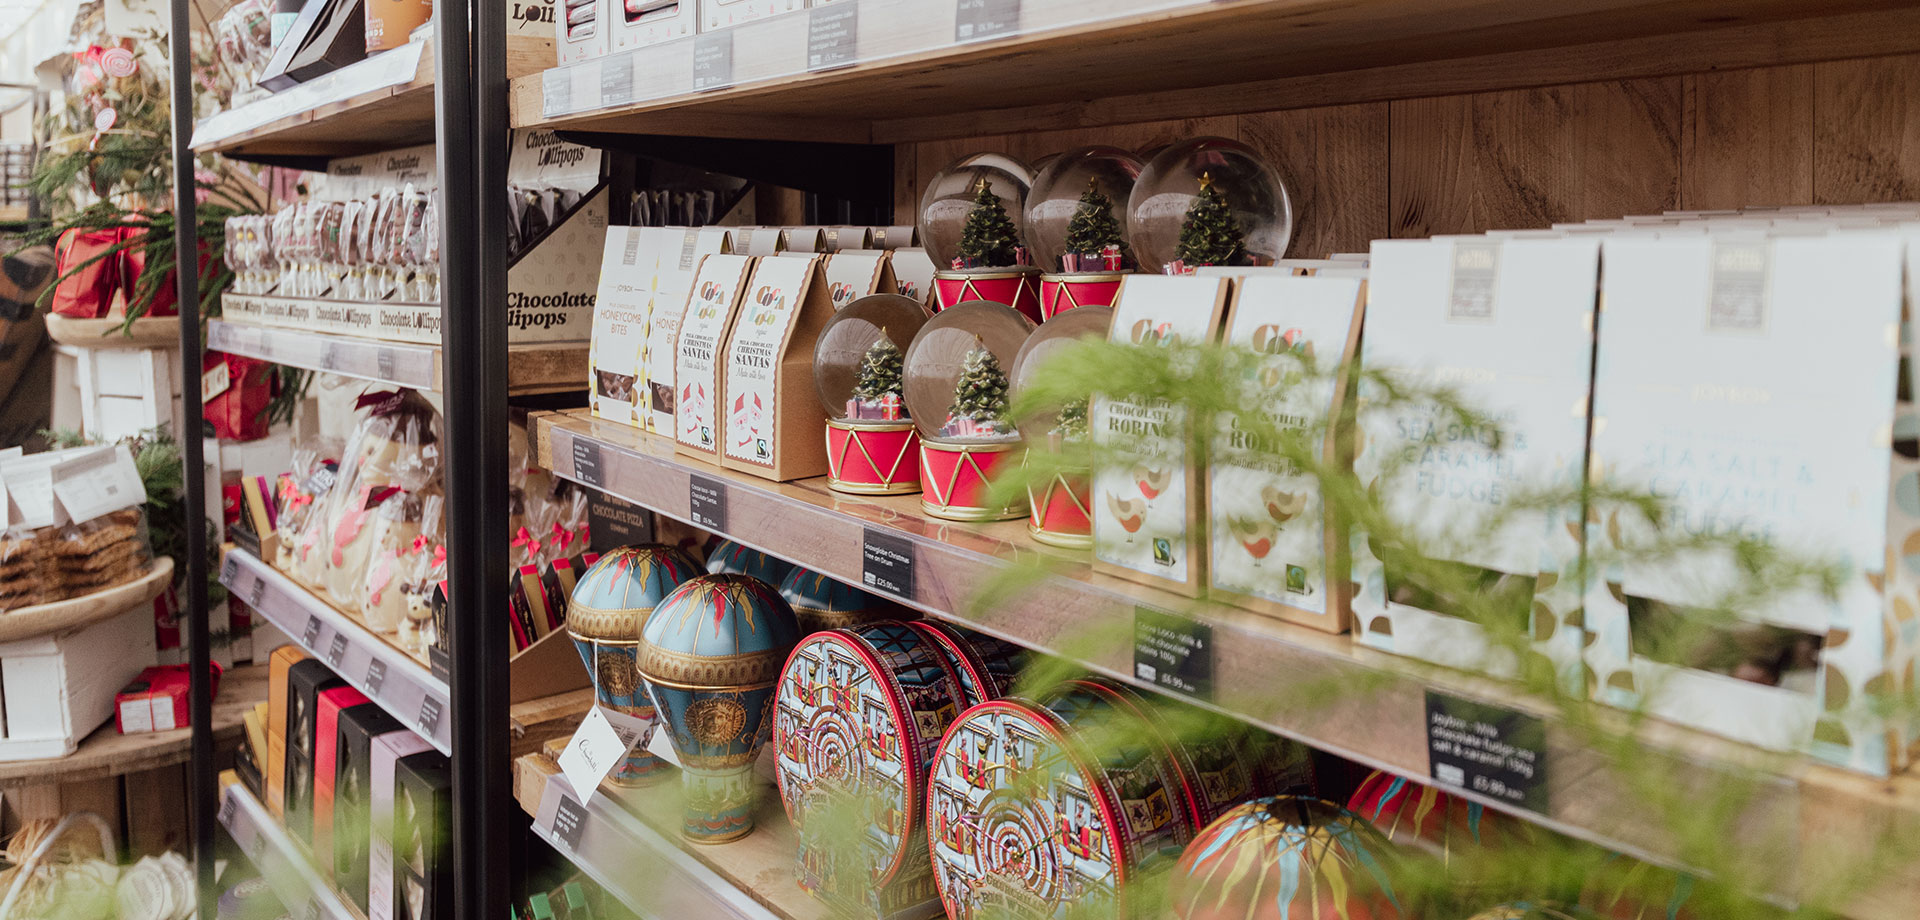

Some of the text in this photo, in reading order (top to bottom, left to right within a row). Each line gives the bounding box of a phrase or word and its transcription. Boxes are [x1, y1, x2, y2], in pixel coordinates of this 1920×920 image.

[537, 146, 585, 169] Lollipops
[507, 292, 598, 308] Chocolate
[316, 306, 372, 328] Chocolate Lollipops
[379, 310, 411, 327] Chocolate
[600, 309, 642, 325] HONEYCOMB
[656, 317, 680, 331] HONEY
[611, 323, 628, 336] BITES
[695, 334, 714, 342] CHOCOLATE
[683, 338, 712, 349] CHRISTMAS
[737, 345, 772, 356] CHRISTMAS
[750, 341, 774, 349] CHOCOLATE
[682, 346, 711, 360] SANTAS
[735, 354, 770, 369] SANTAS
[1109, 403, 1170, 422] CHOCOLATE
[1396, 417, 1437, 443] SEA
[1447, 423, 1503, 449] SALT
[1514, 431, 1528, 450] &
[1403, 445, 1520, 481] CARAMEL
[1416, 470, 1501, 505] FUDGE
[593, 503, 644, 528] CHOCOLATE PIZZA
[865, 542, 910, 564] Snowglobe Christmas
[865, 550, 874, 560] Tree
[881, 557, 893, 567] Drum
[1196, 639, 1203, 649] &
[1431, 725, 1481, 747] chocolate
[1482, 738, 1515, 757] fudge
[1432, 739, 1452, 754] salt
[1462, 747, 1505, 768] caramel
